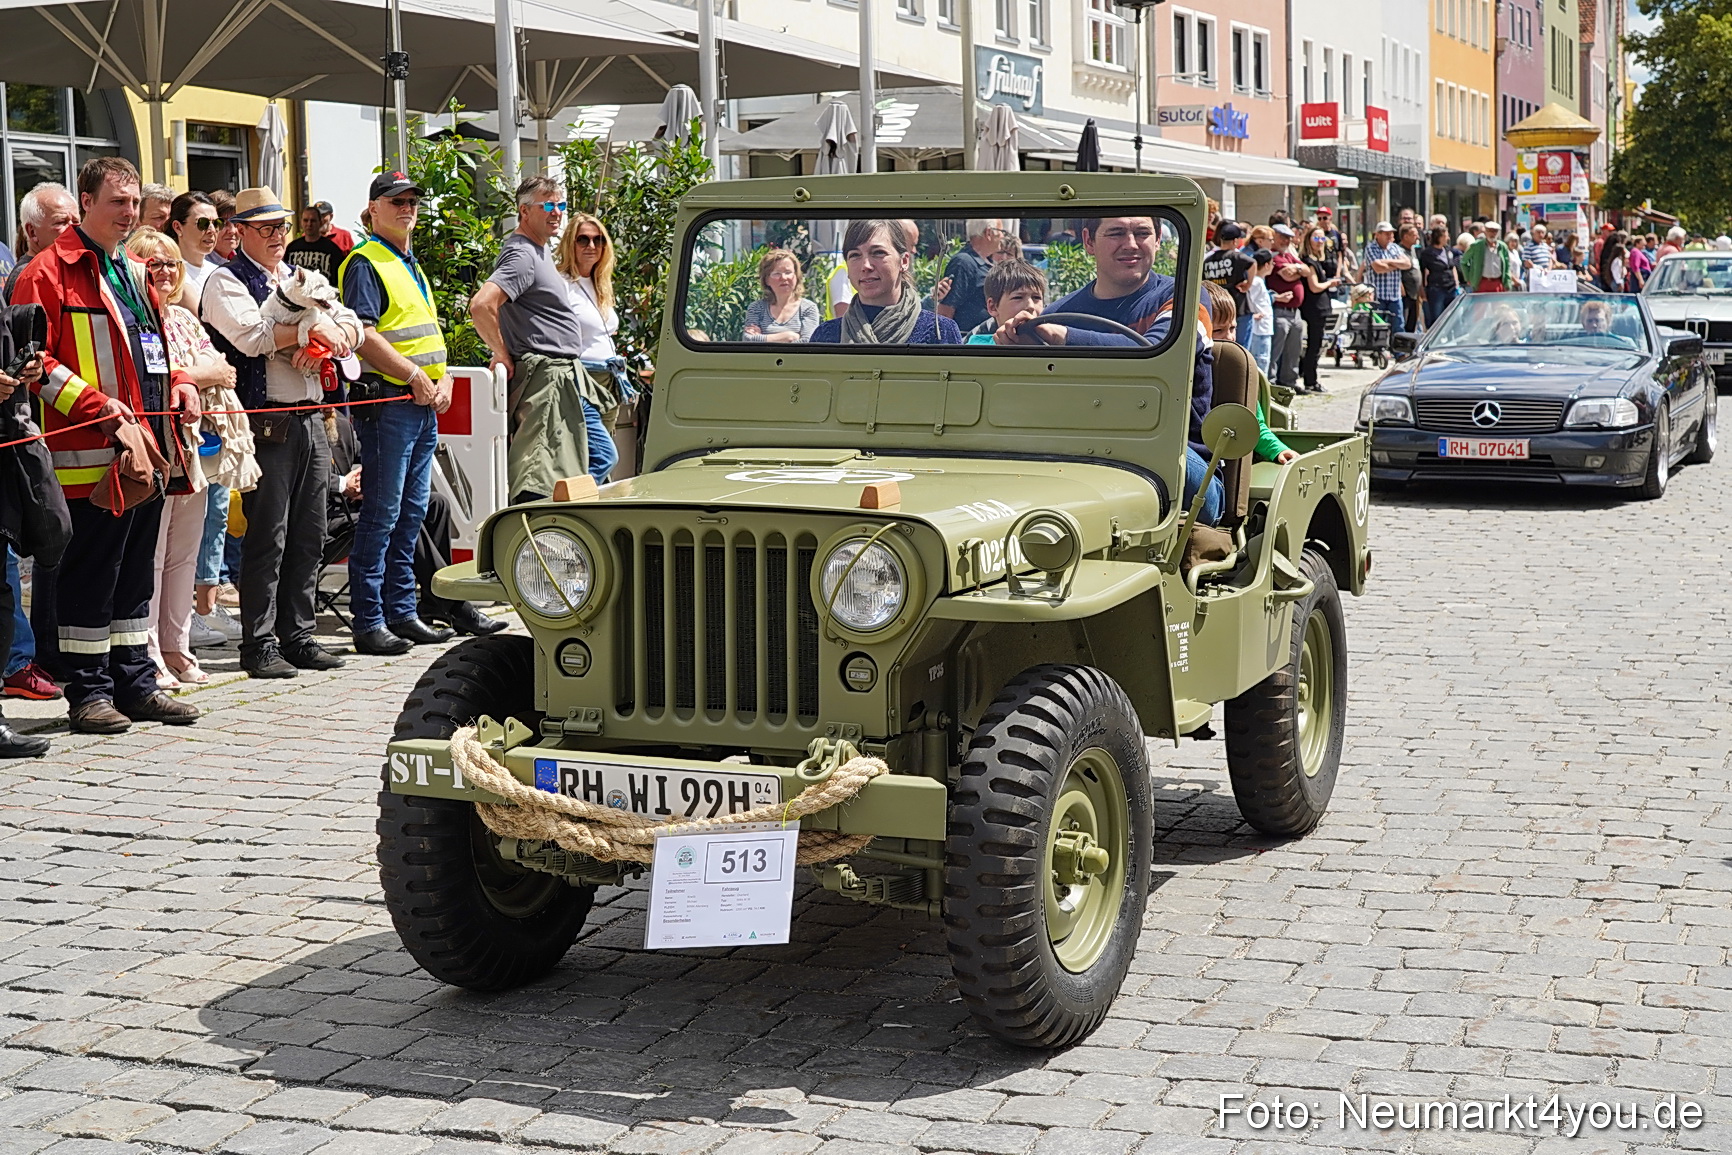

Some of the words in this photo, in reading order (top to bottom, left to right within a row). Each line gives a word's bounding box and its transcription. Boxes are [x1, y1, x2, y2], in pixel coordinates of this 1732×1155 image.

[1204, 266, 1234, 279] HAPPY
[1450, 441, 1469, 456] RH
[1479, 442, 1525, 457] 07041
[560, 767, 604, 806] RH
[628, 773, 672, 816] WI
[681, 777, 750, 819] 99H
[755, 782, 772, 795] 04
[721, 848, 767, 874] 513
